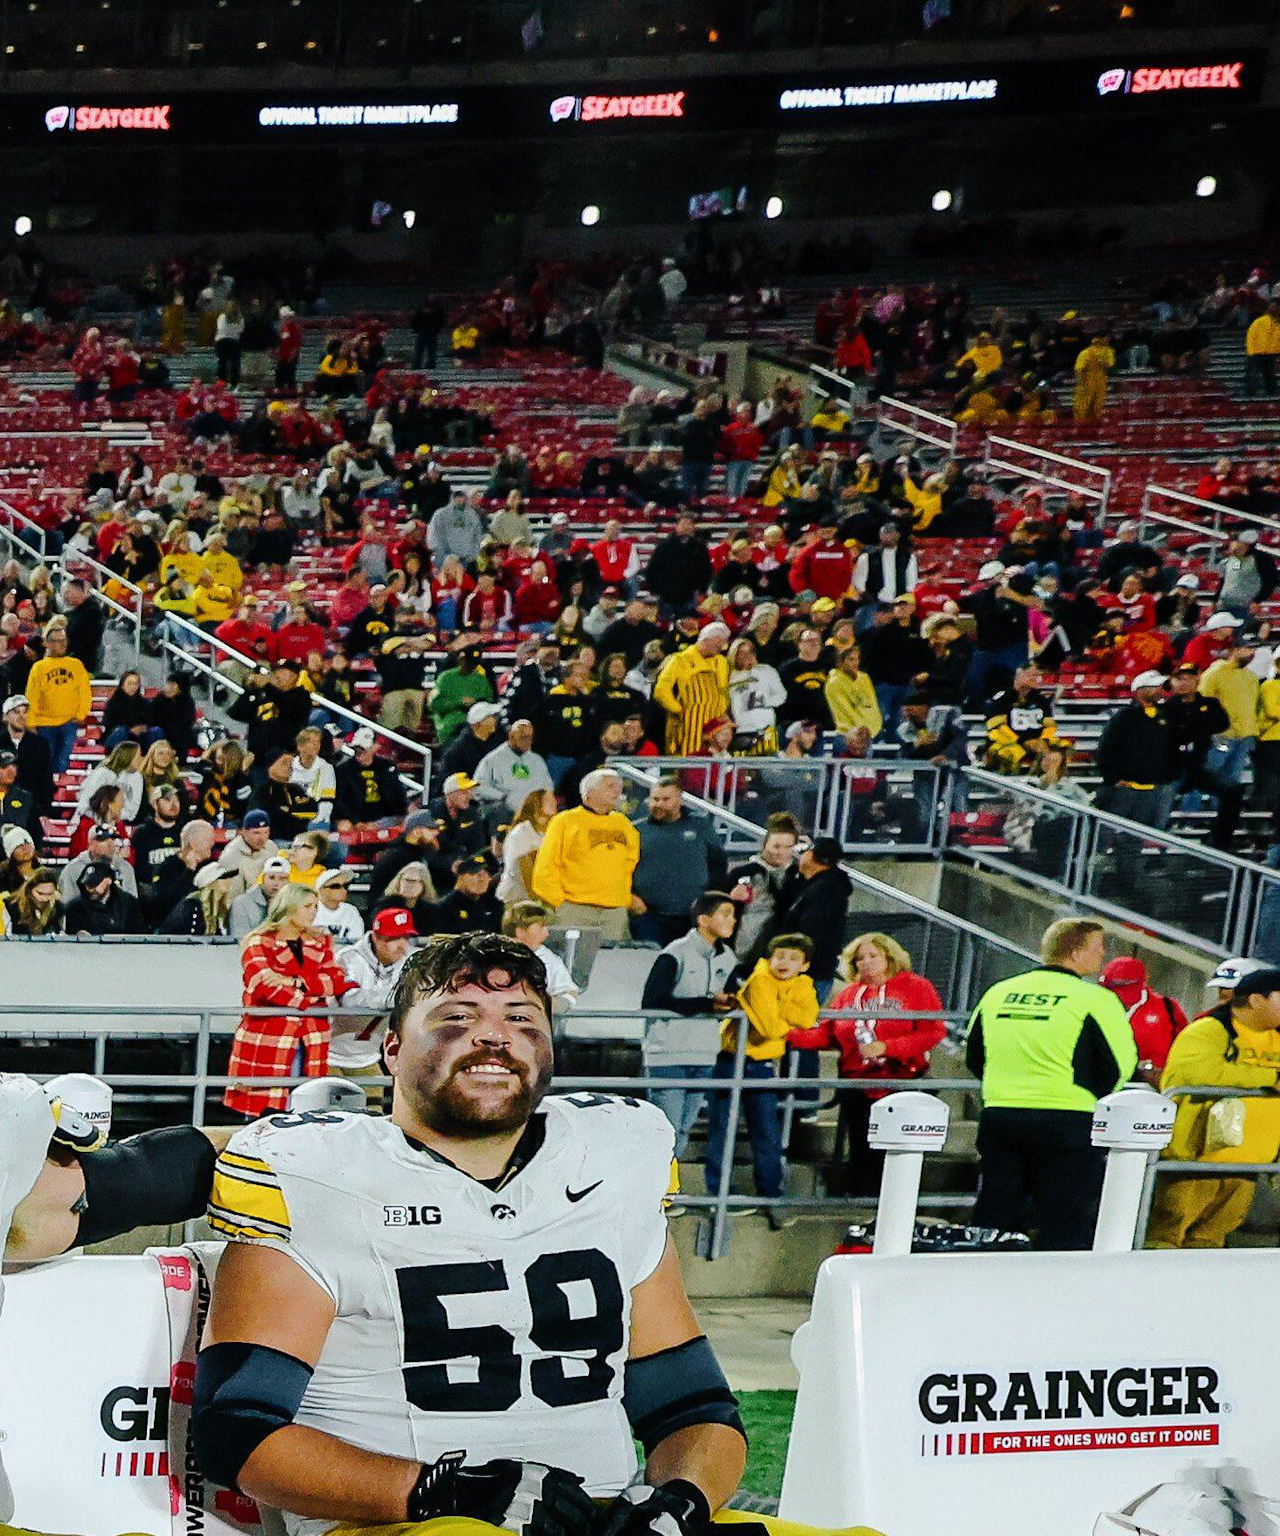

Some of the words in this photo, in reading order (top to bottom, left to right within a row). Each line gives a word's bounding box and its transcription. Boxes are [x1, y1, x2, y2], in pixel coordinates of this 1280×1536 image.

[1133, 64, 1242, 92] SEATGEEK
[76, 106, 170, 130] SEATGEEK
[582, 92, 684, 121] SEATGEEK
[1004, 993, 1068, 1006] BEST
[394, 1248, 625, 1412] 59
[919, 1366, 1221, 1425] GRAINGER
[993, 1435, 1022, 1450] FOR
[1025, 1434, 1051, 1448] THE
[1053, 1433, 1091, 1448] ONES
[1094, 1431, 1127, 1446] WHO
[1130, 1430, 1157, 1445] GET
[1159, 1429, 1171, 1444] IT
[1174, 1428, 1212, 1443] DONE
